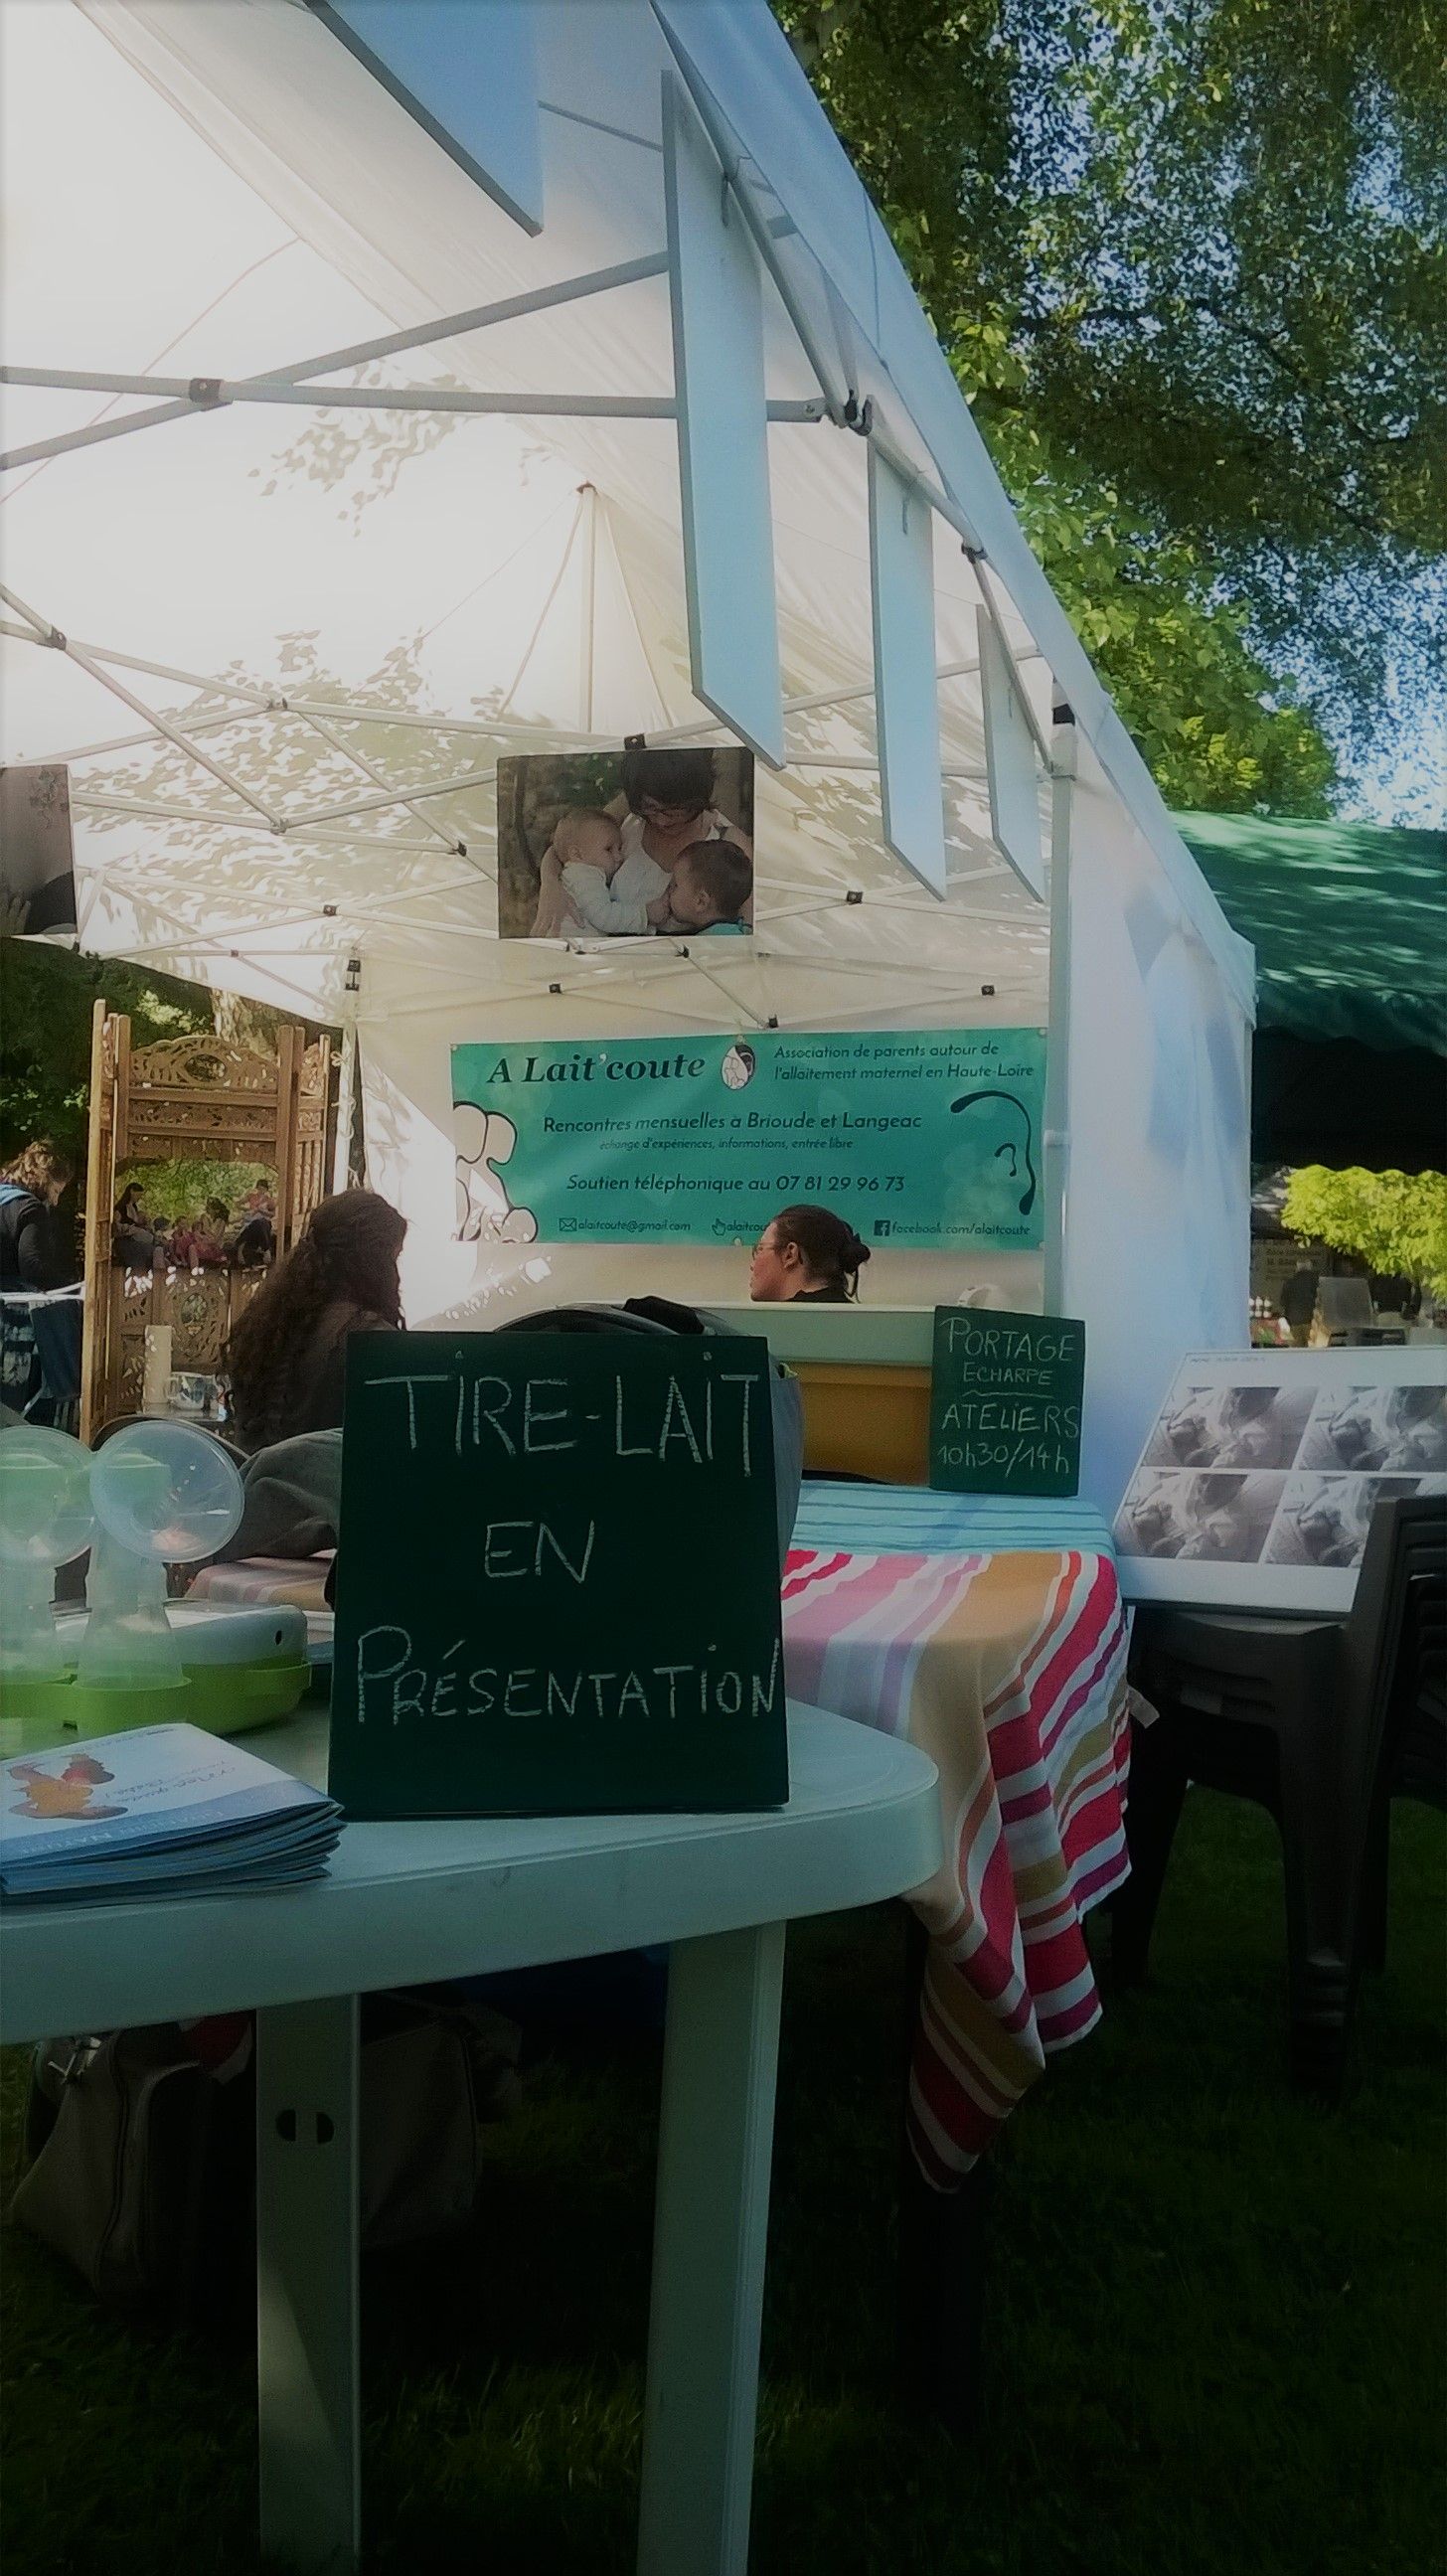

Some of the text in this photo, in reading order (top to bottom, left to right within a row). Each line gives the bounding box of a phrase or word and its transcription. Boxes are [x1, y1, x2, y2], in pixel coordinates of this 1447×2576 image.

[774, 1040, 1000, 1060] Association de parents autour de
[486, 1057, 513, 1083] A
[774, 1062, 1035, 1080] l'allaitement maternel en Haute-Loire
[544, 1115, 631, 1133] Rencontres
[635, 1111, 725, 1130] mensuelles
[747, 1110, 817, 1129] Brioude
[820, 1113, 838, 1129] et
[842, 1111, 922, 1133] Langeac
[829, 1137, 853, 1149] libre
[566, 1173, 905, 1194] Soutien téléphonique au 07 81 29 96 73
[939, 1317, 1075, 1363] PORTAGE
[963, 1362, 1052, 1385] ECHARPE
[937, 1438, 1069, 1478] 10h30/14h
[485, 1521, 594, 1583] EN
